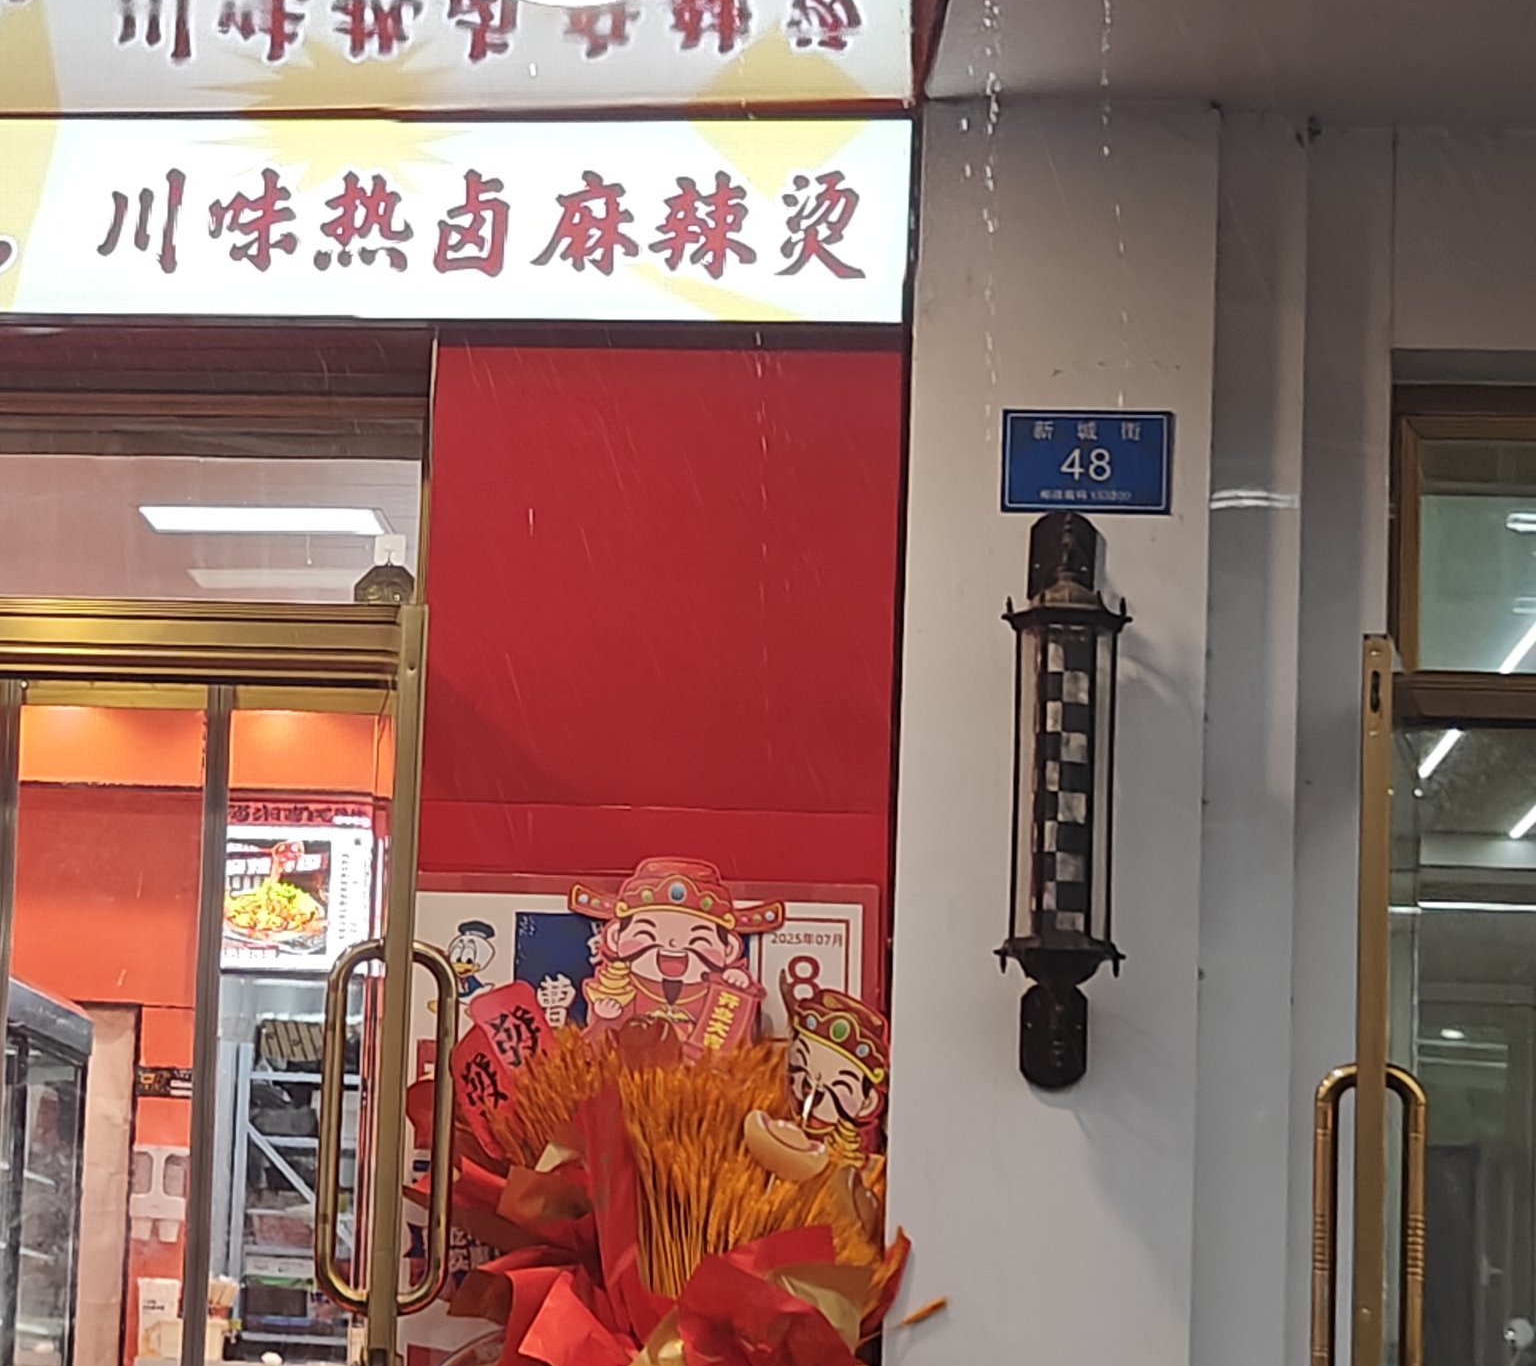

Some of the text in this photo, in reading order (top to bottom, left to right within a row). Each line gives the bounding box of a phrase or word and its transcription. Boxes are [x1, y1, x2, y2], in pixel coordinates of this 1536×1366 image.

[97, 166, 866, 280] 川味热卤麻辣烫
[1032, 420, 1141, 441] 新城街
[1060, 448, 1111, 481] 48
[771, 933, 843, 947] 2025年07月
